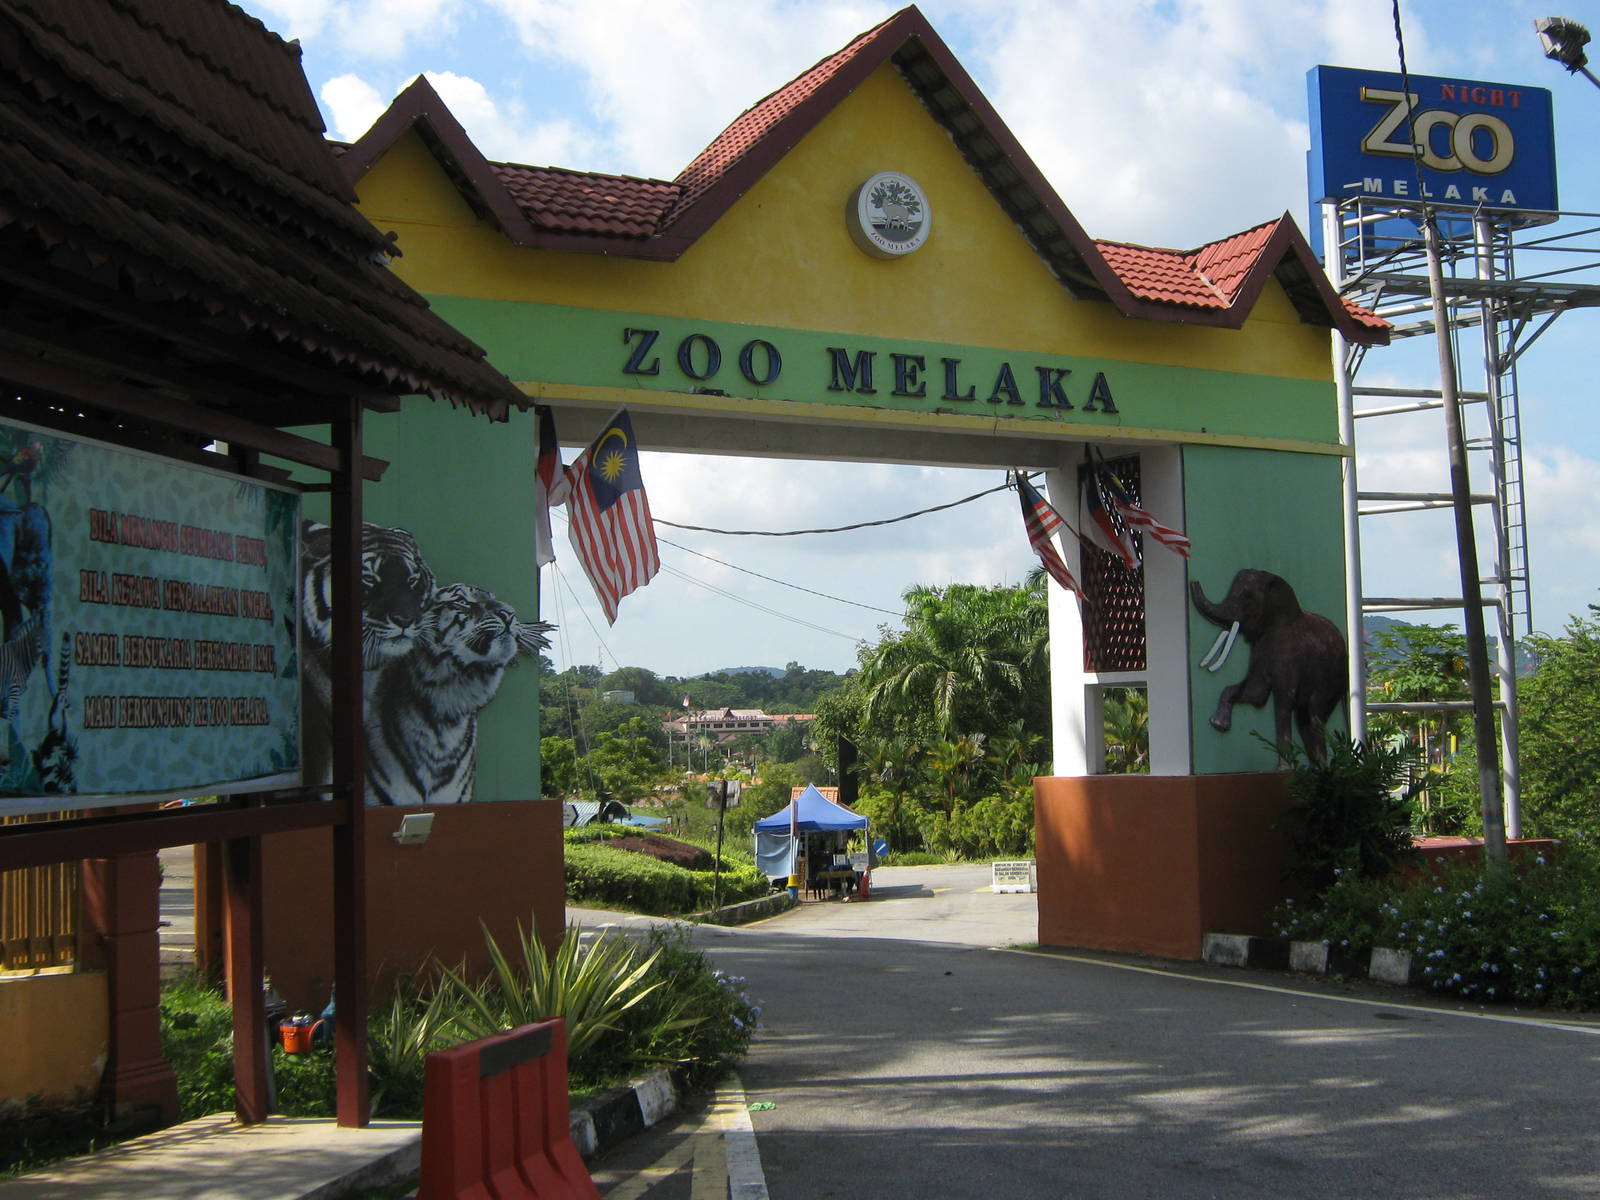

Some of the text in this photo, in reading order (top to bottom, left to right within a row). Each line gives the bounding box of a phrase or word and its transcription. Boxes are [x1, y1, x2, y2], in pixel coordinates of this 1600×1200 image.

[1440, 84, 1521, 107] NIGHT
[1360, 86, 1515, 176] ZOO
[1364, 177, 1517, 204] MELAKA
[871, 232, 885, 245] ZOO
[622, 327, 1119, 414] ZOO MELAKA
[90, 508, 119, 544] BILA
[80, 569, 109, 604] BILA
[111, 573, 160, 609] KETAWA
[163, 580, 238, 616] MENGALAHKAN
[75, 632, 121, 666] SAMBIL
[123, 635, 192, 669] BERSUKARIA
[194, 640, 251, 671] BERTAMBAH
[84, 696, 117, 729] MARI
[119, 695, 191, 728] BERKUNJUNG
[194, 697, 209, 727] KE
[210, 697, 228, 726] ZOO
